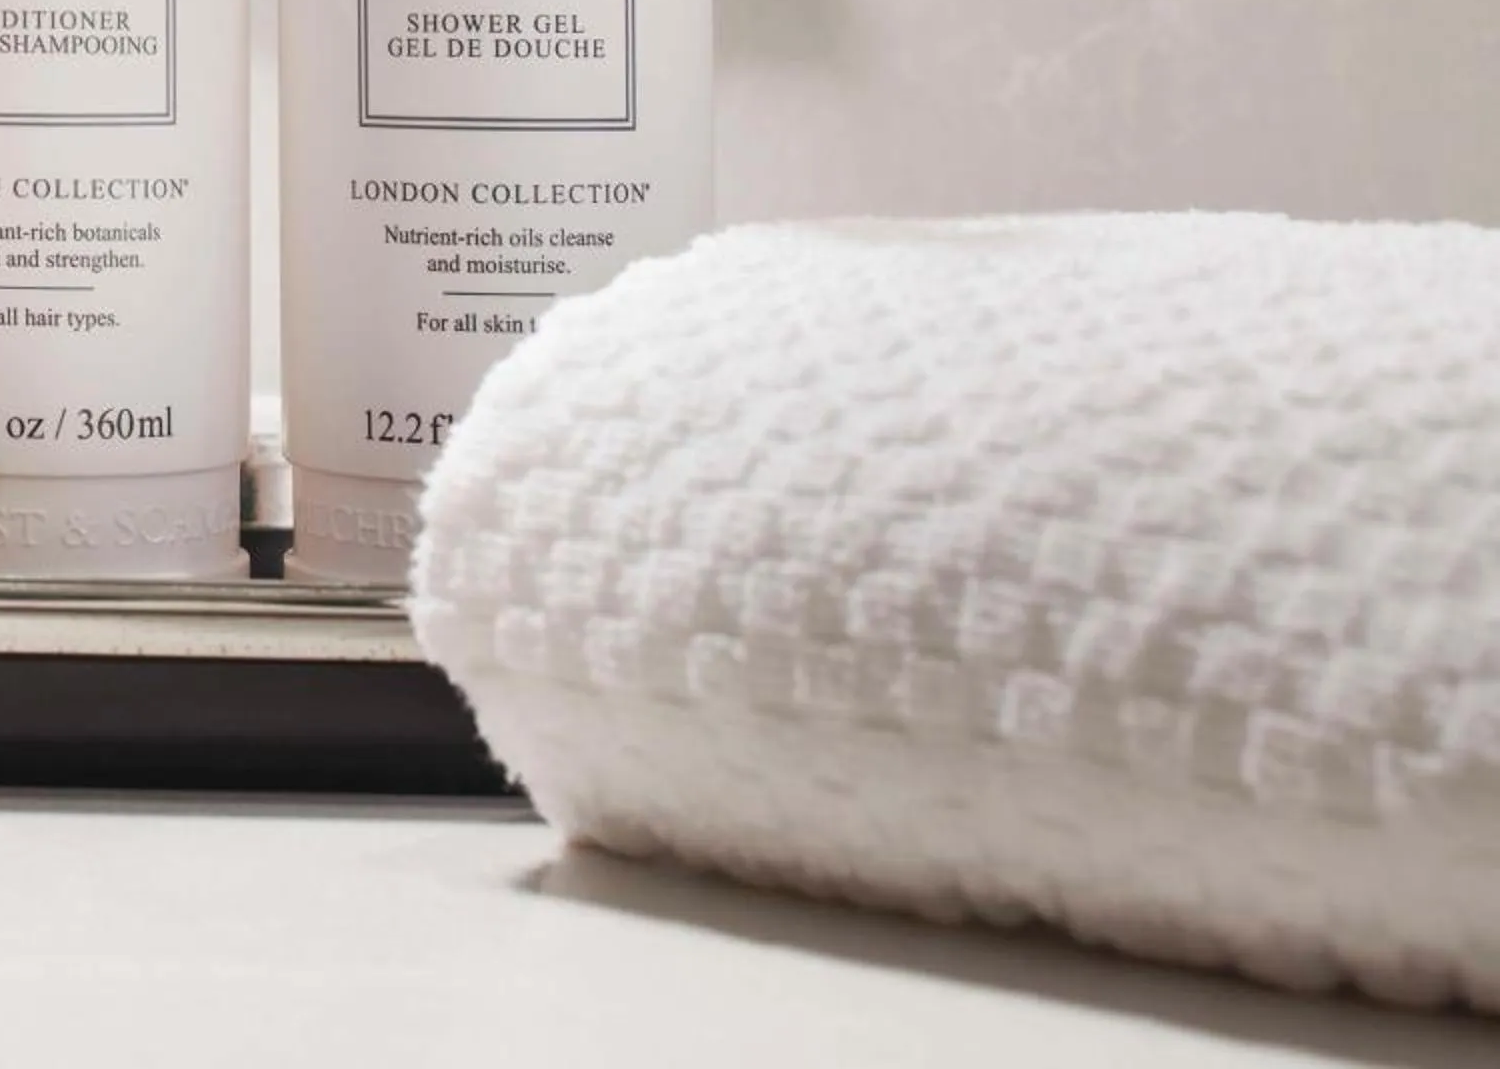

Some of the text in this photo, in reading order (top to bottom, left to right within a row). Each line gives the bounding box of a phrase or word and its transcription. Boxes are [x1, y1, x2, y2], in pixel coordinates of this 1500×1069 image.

[407, 13, 585, 34] SHOWER GEL
[388, 37, 605, 59] GEL DE DOUCHE
[351, 179, 459, 203] LONDON
[72, 222, 161, 242] botanicals
[384, 224, 614, 247] Nutrient-rich oils cleanse
[6, 249, 40, 268] and
[45, 250, 144, 274] strengthen.
[427, 254, 571, 274] and moisturise.
[25, 307, 62, 327] hair
[67, 312, 120, 332] types.
[417, 312, 449, 331] For
[454, 313, 477, 333] all
[484, 314, 524, 334] skin
[6, 417, 44, 439] oz
[55, 407, 67, 440] /
